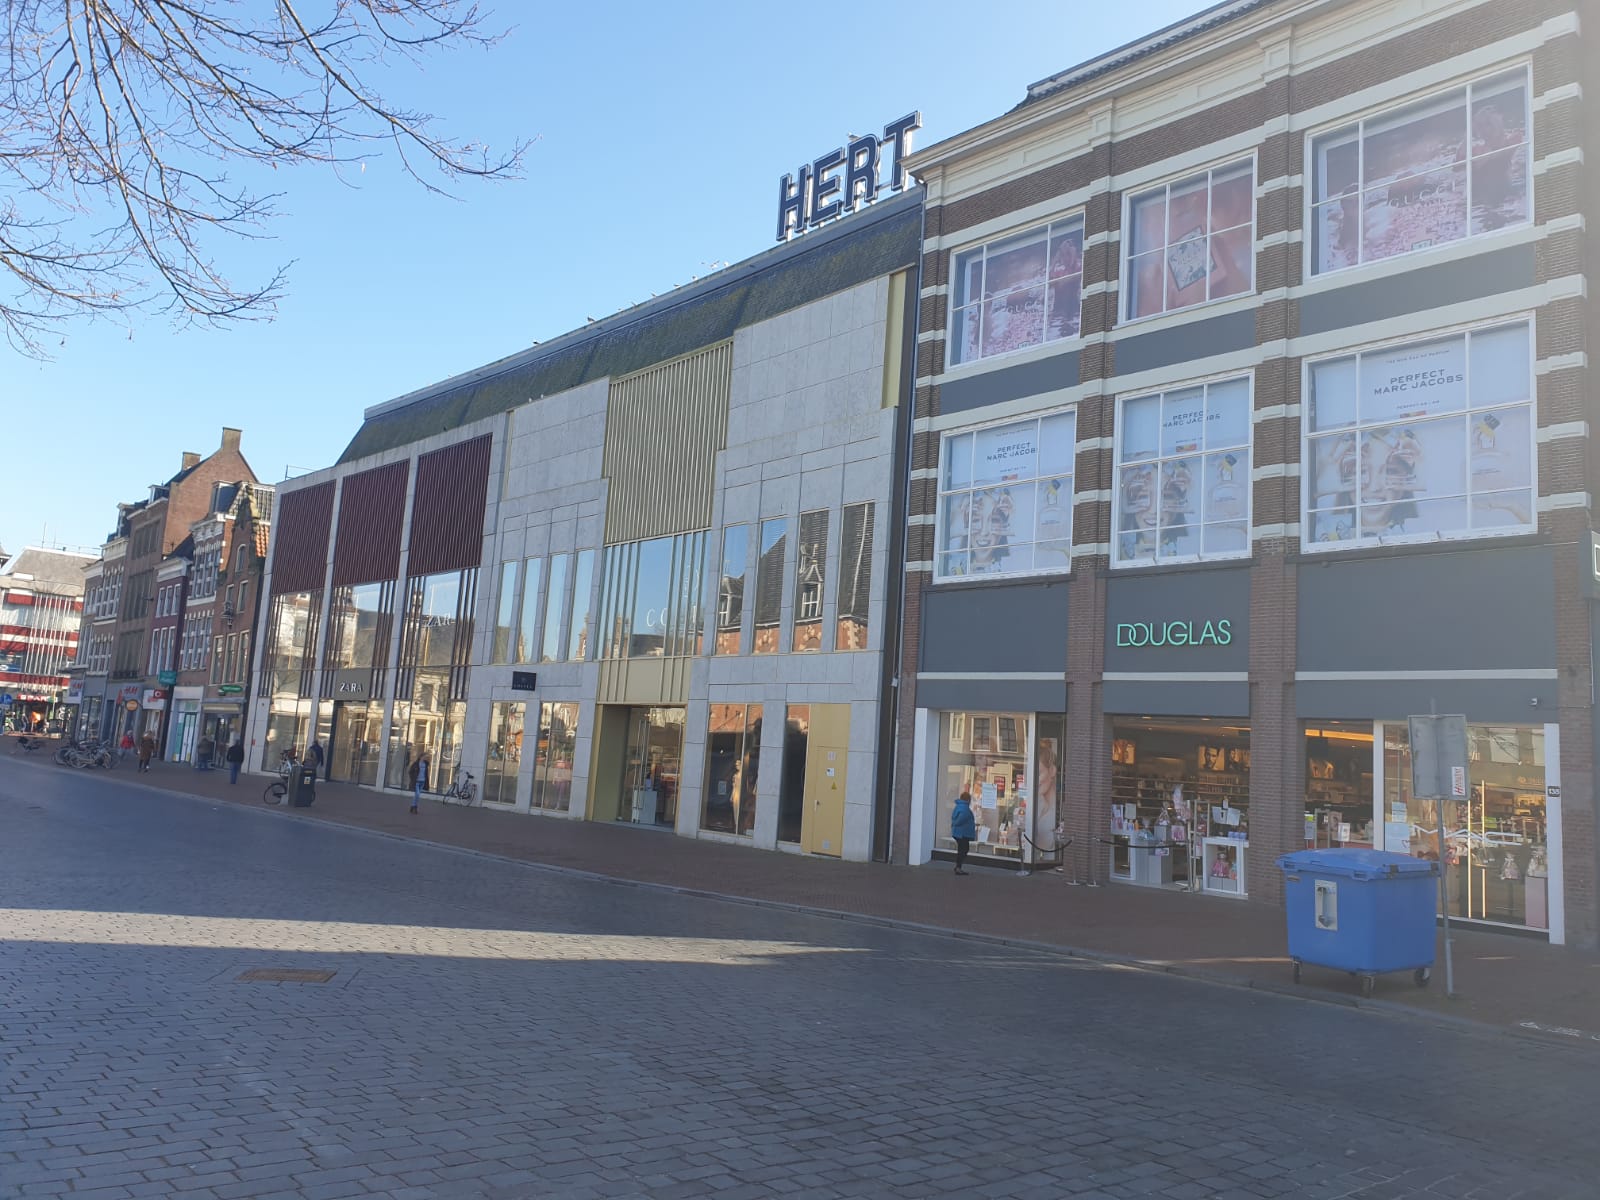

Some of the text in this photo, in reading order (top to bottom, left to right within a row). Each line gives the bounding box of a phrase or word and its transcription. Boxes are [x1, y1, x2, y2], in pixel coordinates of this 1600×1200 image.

[776, 111, 922, 241] HERT
[1390, 368, 1445, 385] PERFECT
[1374, 374, 1464, 395] MARC JACOBS
[1172, 410, 1206, 421] PERFEC
[996, 441, 1031, 453] PERFECT
[1009, 447, 1037, 457] JACOB
[1116, 619, 1231, 647] DOUGLAS
[339, 682, 363, 693] ZARA
